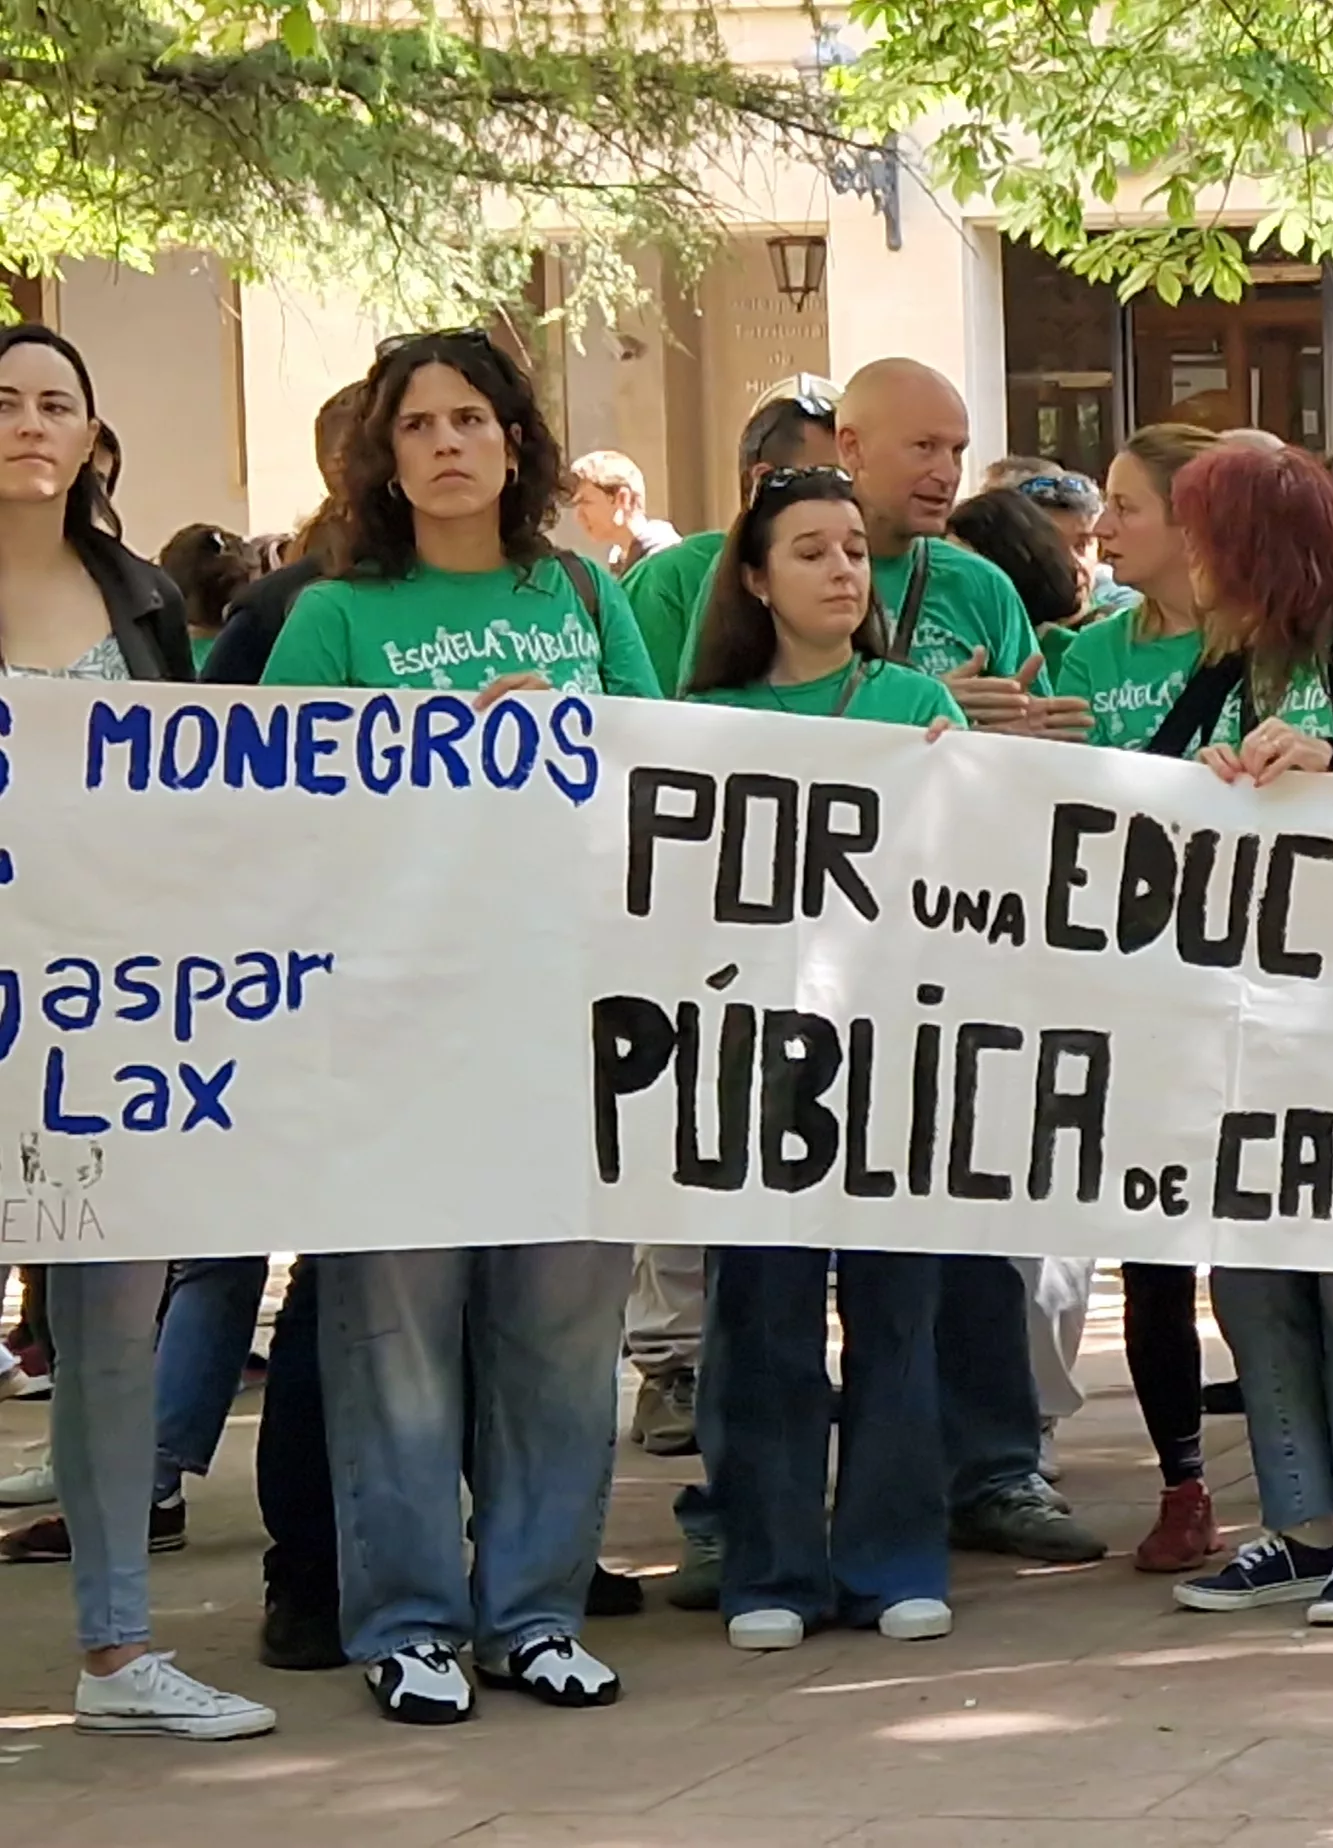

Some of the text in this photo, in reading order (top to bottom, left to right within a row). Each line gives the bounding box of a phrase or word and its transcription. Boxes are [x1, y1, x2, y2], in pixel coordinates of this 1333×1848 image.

[384, 626, 507, 676] ESCUELA
[1092, 679, 1173, 713] SCUELA
[85, 693, 600, 806] MONEGROS
[626, 766, 881, 925] POR
[911, 877, 1026, 947] UNA
[42, 1046, 238, 1135] Lax
[1123, 1165, 1189, 1217] DE
